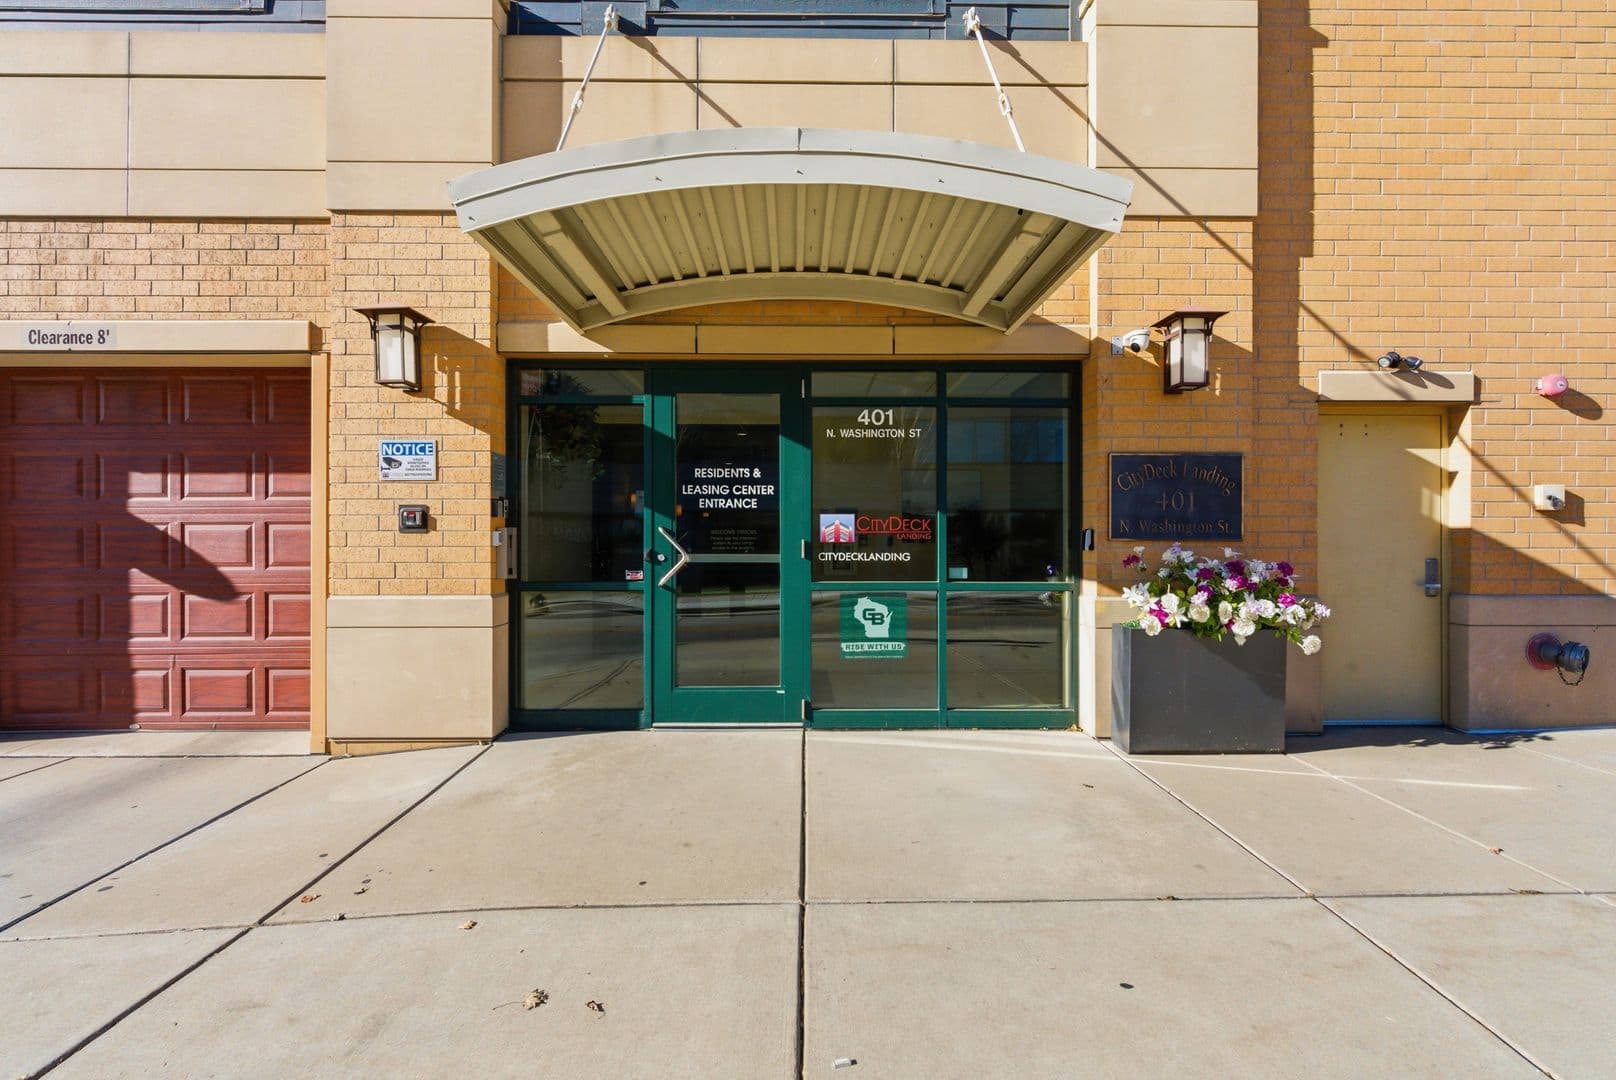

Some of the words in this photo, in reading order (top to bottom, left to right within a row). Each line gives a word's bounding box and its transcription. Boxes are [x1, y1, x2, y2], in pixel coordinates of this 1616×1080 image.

[28, 329, 93, 345] Clearance
[97, 329, 110, 345] 8'
[857, 408, 894, 426] 401
[826, 428, 836, 438] N.
[840, 428, 905, 438] WASHINGTON
[908, 428, 922, 438] ST
[382, 443, 433, 455] NOTICE
[694, 467, 750, 479] RESIDENTS
[752, 467, 762, 479] &
[1117, 459, 1178, 492] CityDeck
[1183, 460, 1236, 497] Landing
[682, 484, 730, 495] LEASING
[732, 484, 775, 495] CENTER
[698, 498, 758, 509] ENTRANCE
[1154, 489, 1195, 513] 401
[1119, 519, 1134, 534] N.
[1139, 519, 1213, 536] Washington
[1217, 519, 1234, 534] St.
[862, 608, 885, 626] GB
[845, 643, 865, 651] RISE
